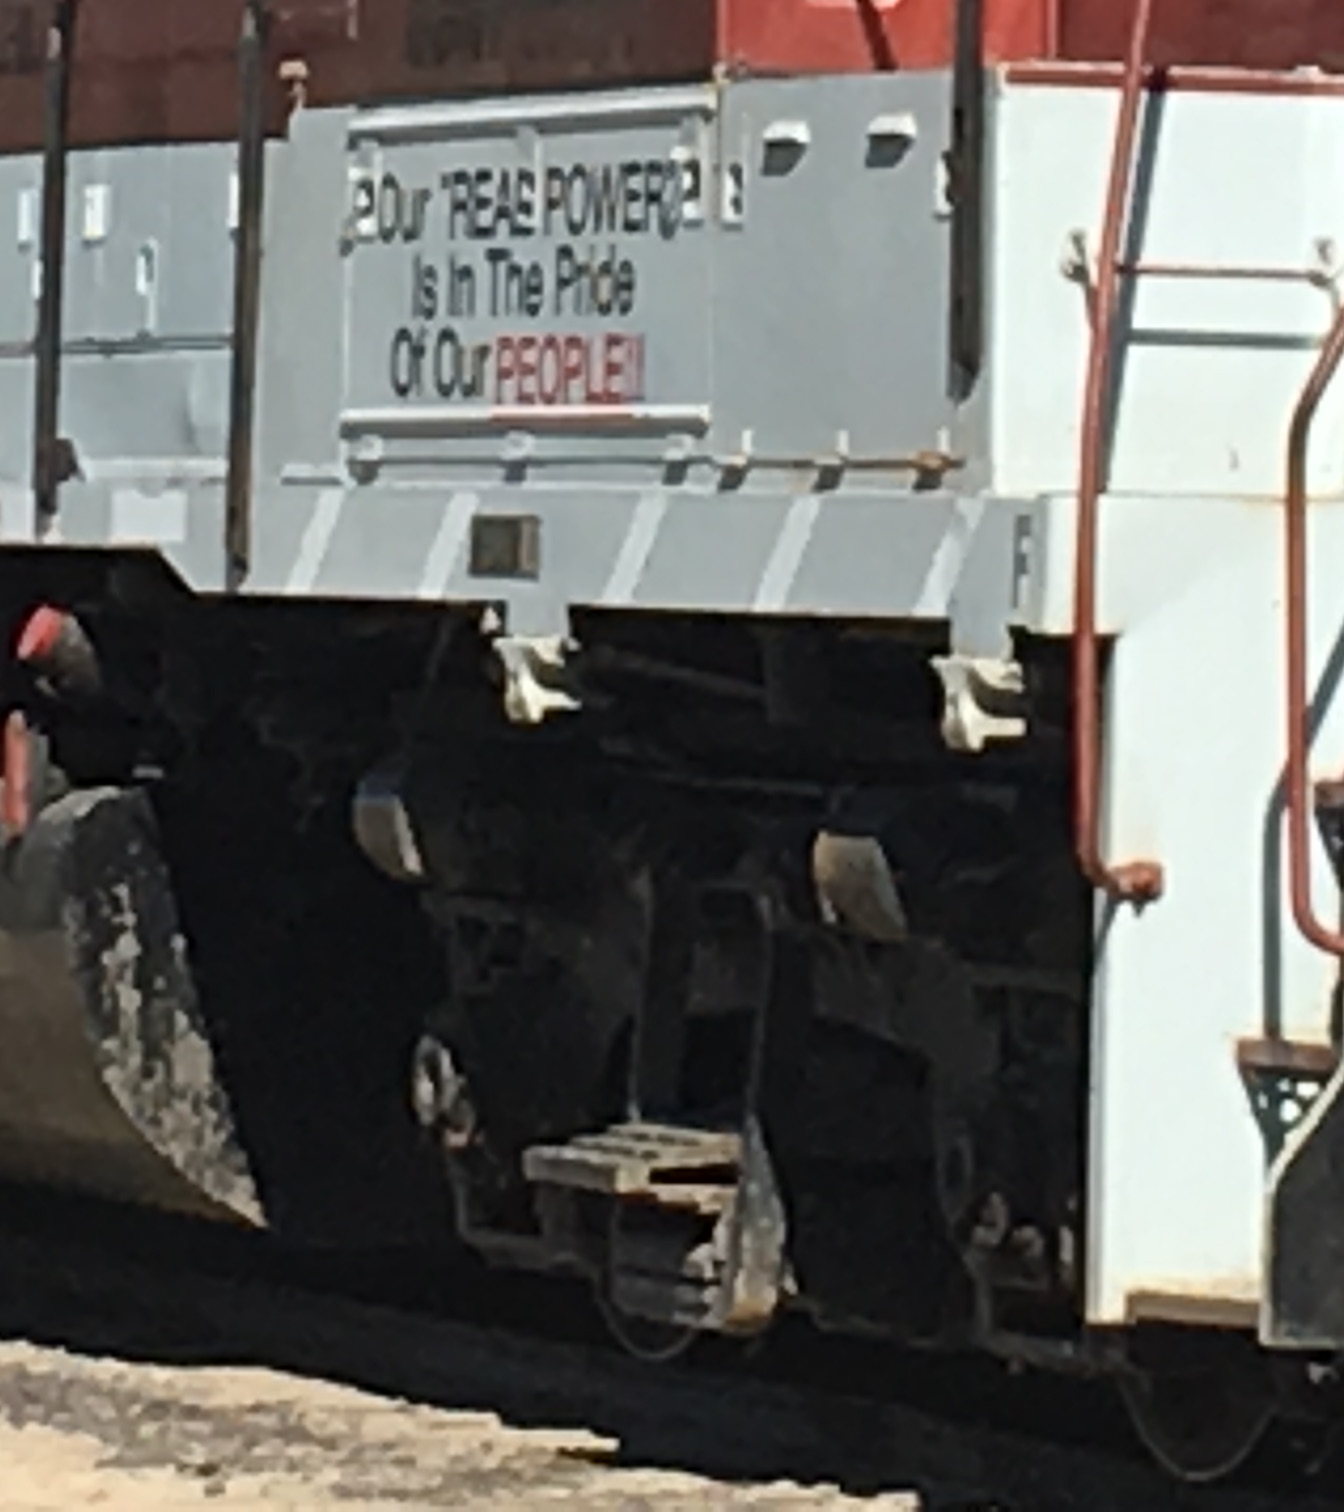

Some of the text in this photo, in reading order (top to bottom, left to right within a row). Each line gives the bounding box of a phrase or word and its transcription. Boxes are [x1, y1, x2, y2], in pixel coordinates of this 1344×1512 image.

[412, 244, 635, 321] Is In The Pride
[391, 326, 427, 397] Of
[433, 326, 491, 398] Our
